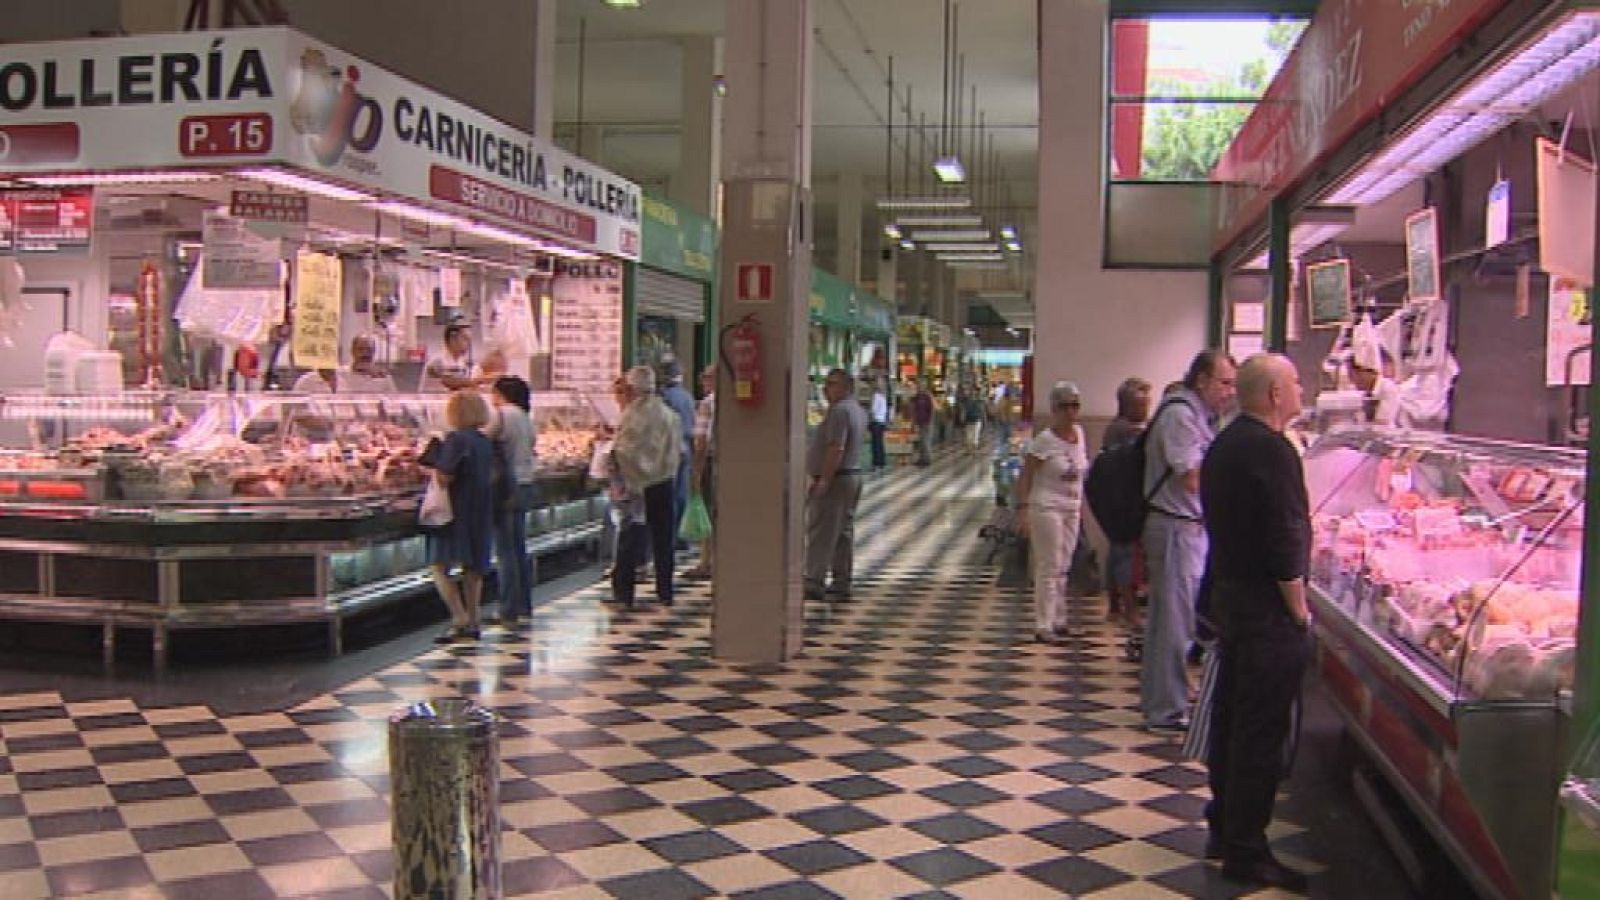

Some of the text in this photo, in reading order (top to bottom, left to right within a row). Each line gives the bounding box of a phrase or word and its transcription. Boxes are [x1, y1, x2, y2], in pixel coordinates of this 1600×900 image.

[188, 122, 264, 151] P. 15
[394, 96, 548, 192] CARNICERÍA
[563, 164, 639, 222] POLLERÍA
